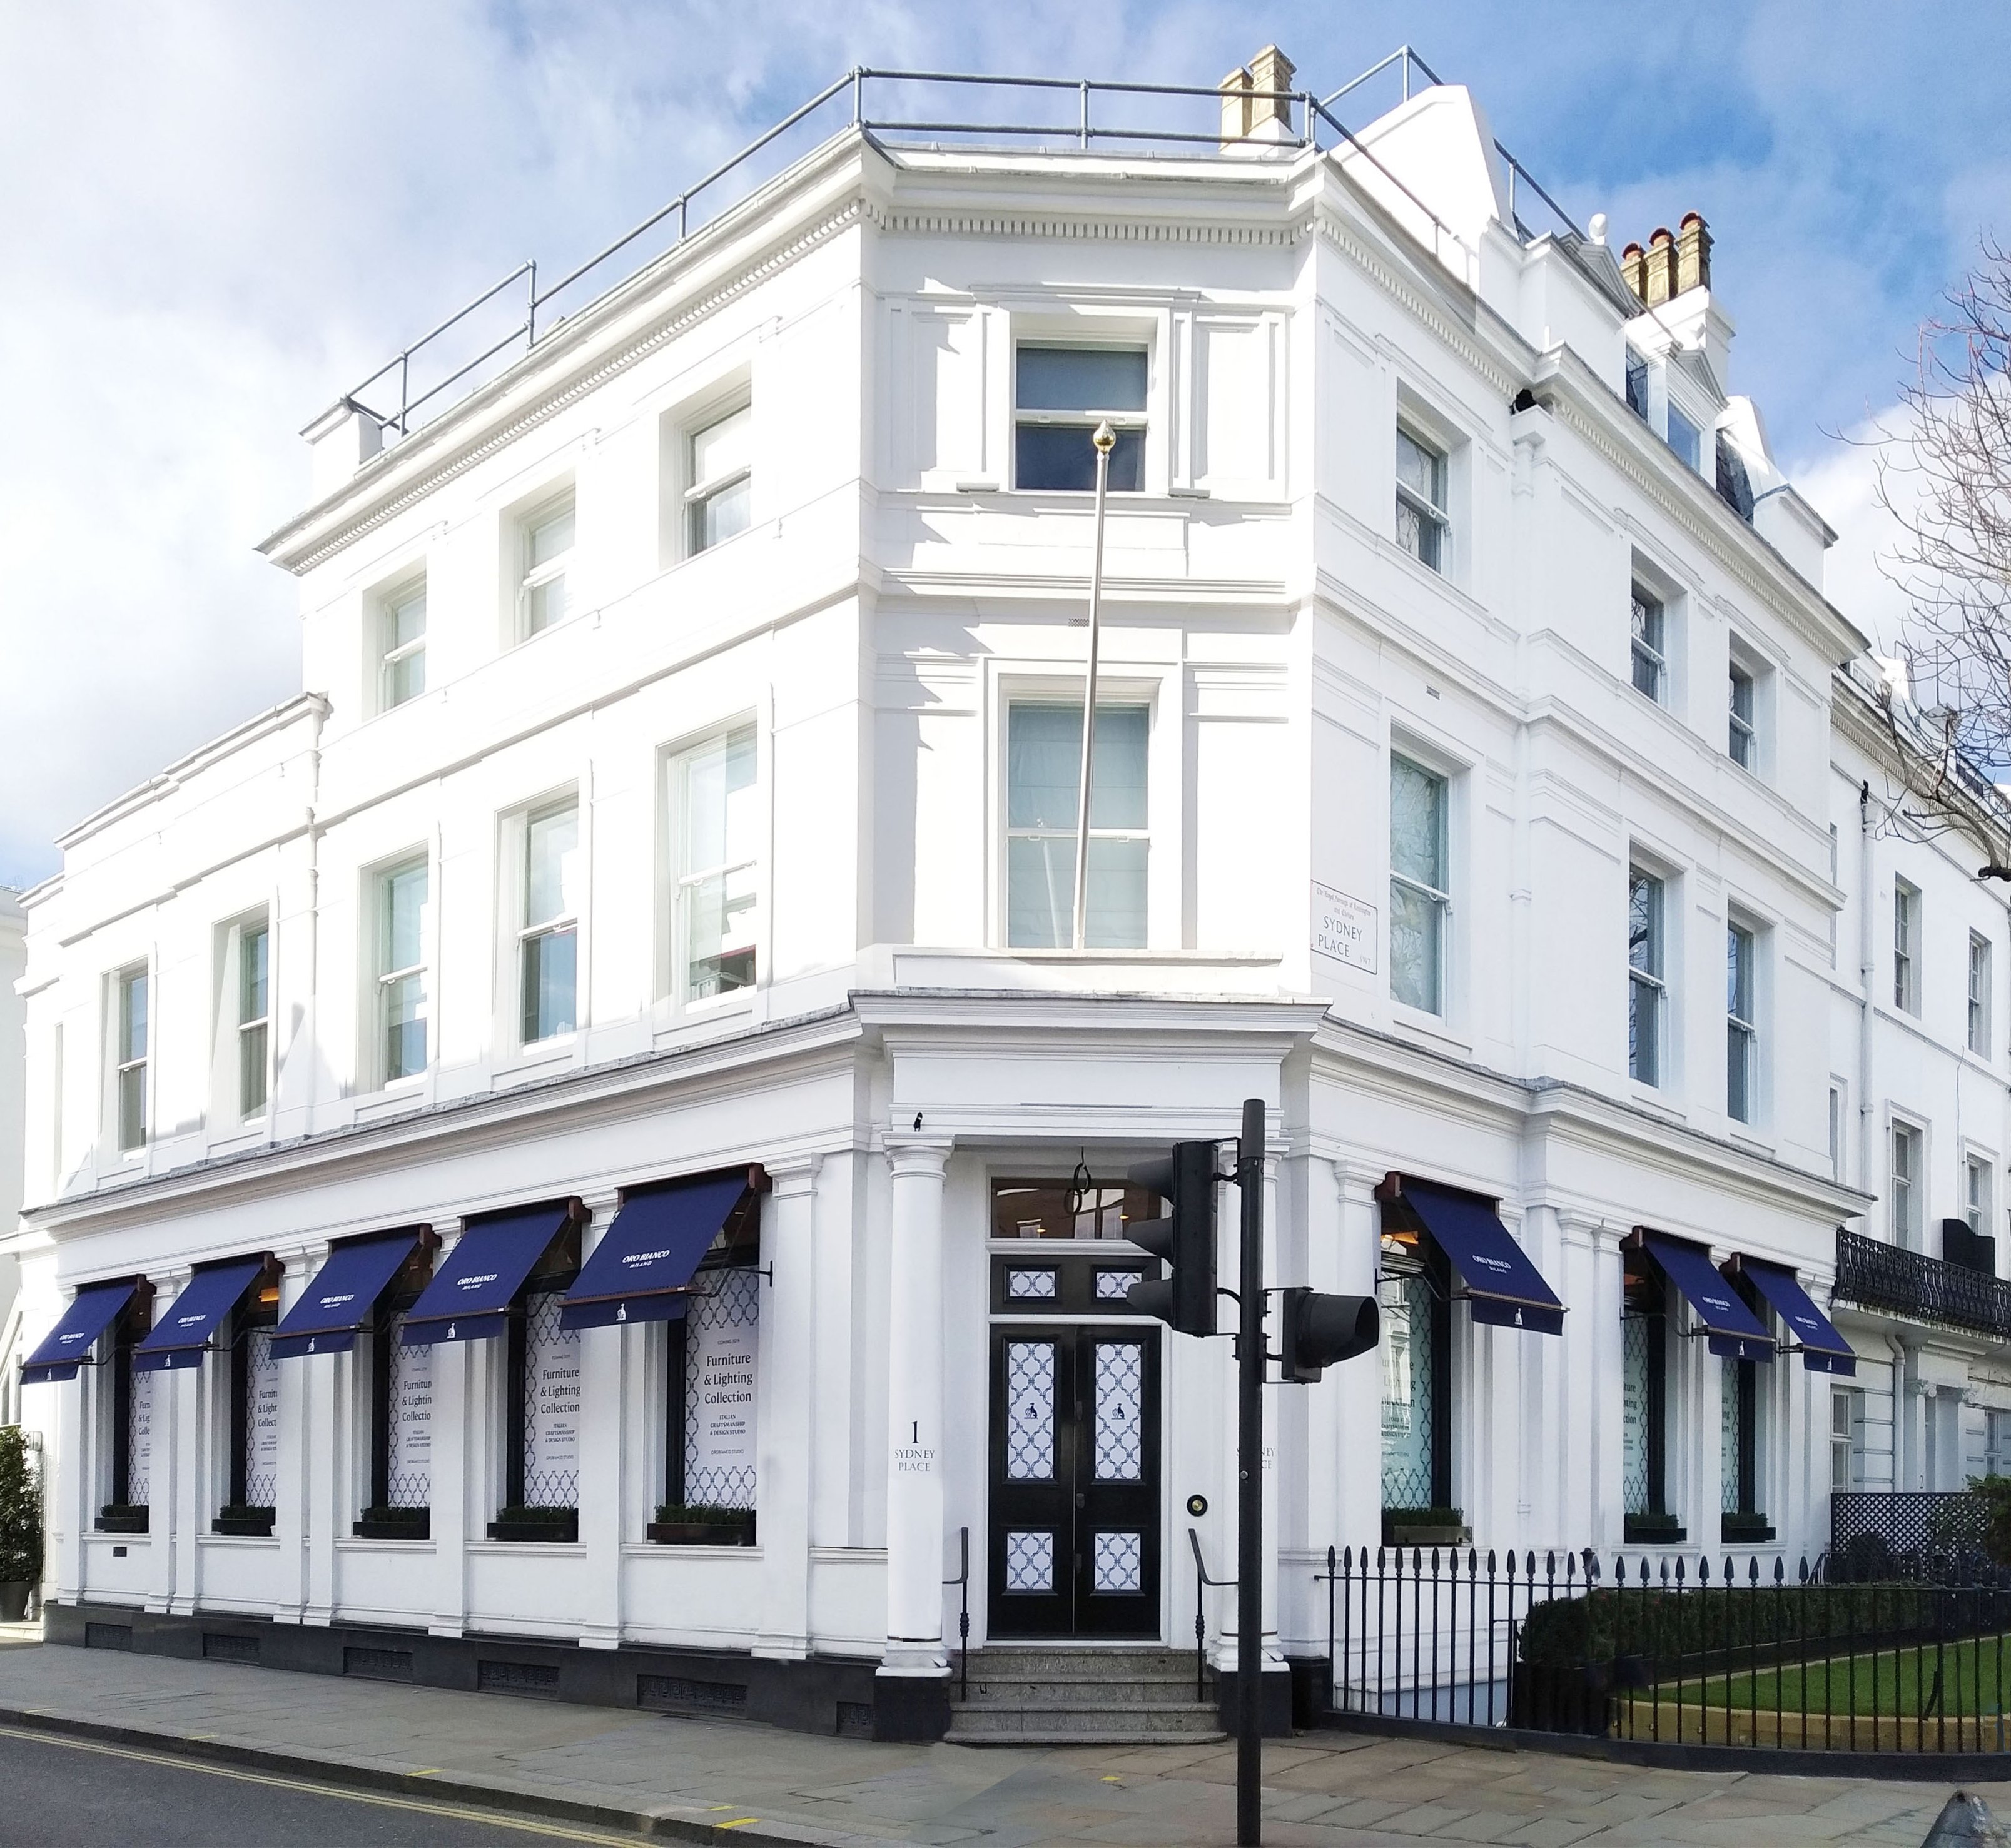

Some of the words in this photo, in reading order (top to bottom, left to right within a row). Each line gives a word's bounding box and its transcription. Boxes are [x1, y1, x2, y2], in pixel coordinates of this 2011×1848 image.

[1324, 916, 1362, 942] SYDNEY
[1318, 934, 1350, 958] PLACE
[622, 1254, 640, 1263] ORO
[639, 1250, 670, 1261] BIANCO
[629, 1260, 652, 1268] MILANO
[707, 1353, 751, 1366] Furniture
[543, 1368, 579, 1380] Furniture
[704, 1374, 711, 1386] &
[714, 1371, 752, 1387] Lighting
[540, 1386, 547, 1397] &
[548, 1384, 580, 1398] Lighting
[705, 1390, 751, 1404] Collection
[402, 1396, 407, 1406] &
[408, 1394, 432, 1407] Lightin
[263, 1403, 277, 1415] Light
[540, 1401, 580, 1414] Collection
[402, 1410, 431, 1421] Collectio
[258, 1418, 276, 1427] Collect
[911, 1420, 919, 1443] 1
[894, 1449, 935, 1458] SYDNEY
[898, 1462, 930, 1471] PLACE
